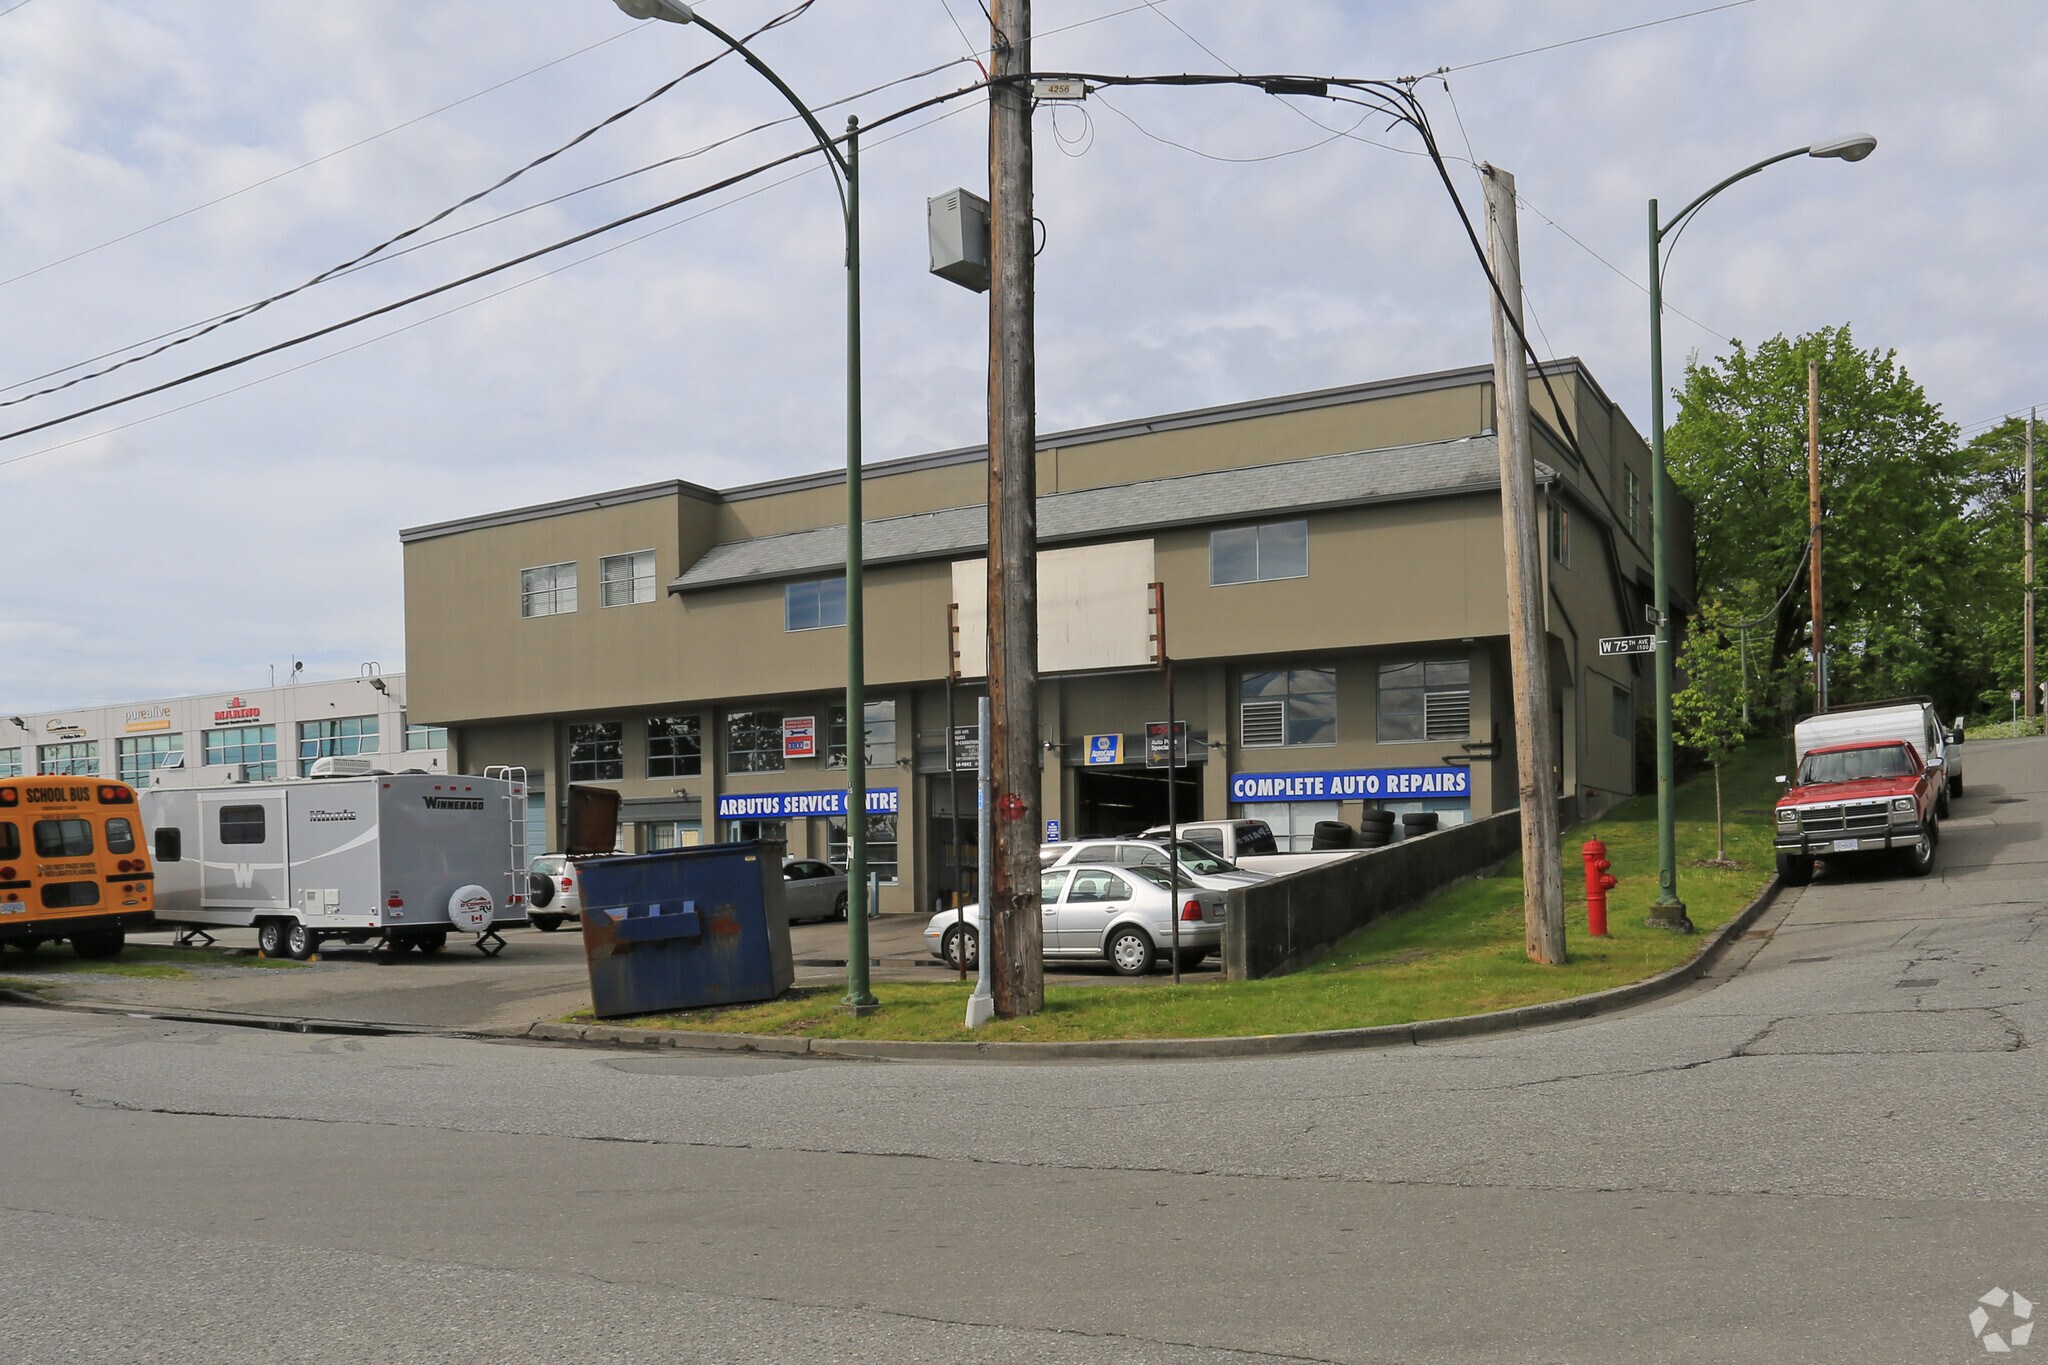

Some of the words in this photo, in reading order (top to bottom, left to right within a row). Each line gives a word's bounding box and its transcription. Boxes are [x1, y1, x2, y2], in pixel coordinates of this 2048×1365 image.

[1048, 85, 1070, 93] 4256
[1602, 641, 1612, 653] W
[125, 704, 171, 723] purealive
[214, 707, 260, 721] MARINO
[1234, 776, 1324, 797] COMPLETE
[1330, 775, 1380, 795] AUTO
[1386, 772, 1466, 793] REPAIRS
[26, 788, 67, 803] SCHOOL
[70, 787, 90, 801] BUS
[720, 798, 780, 815] ARBUTUS
[784, 795, 839, 812] SERVICE
[309, 809, 356, 822] Minnie
